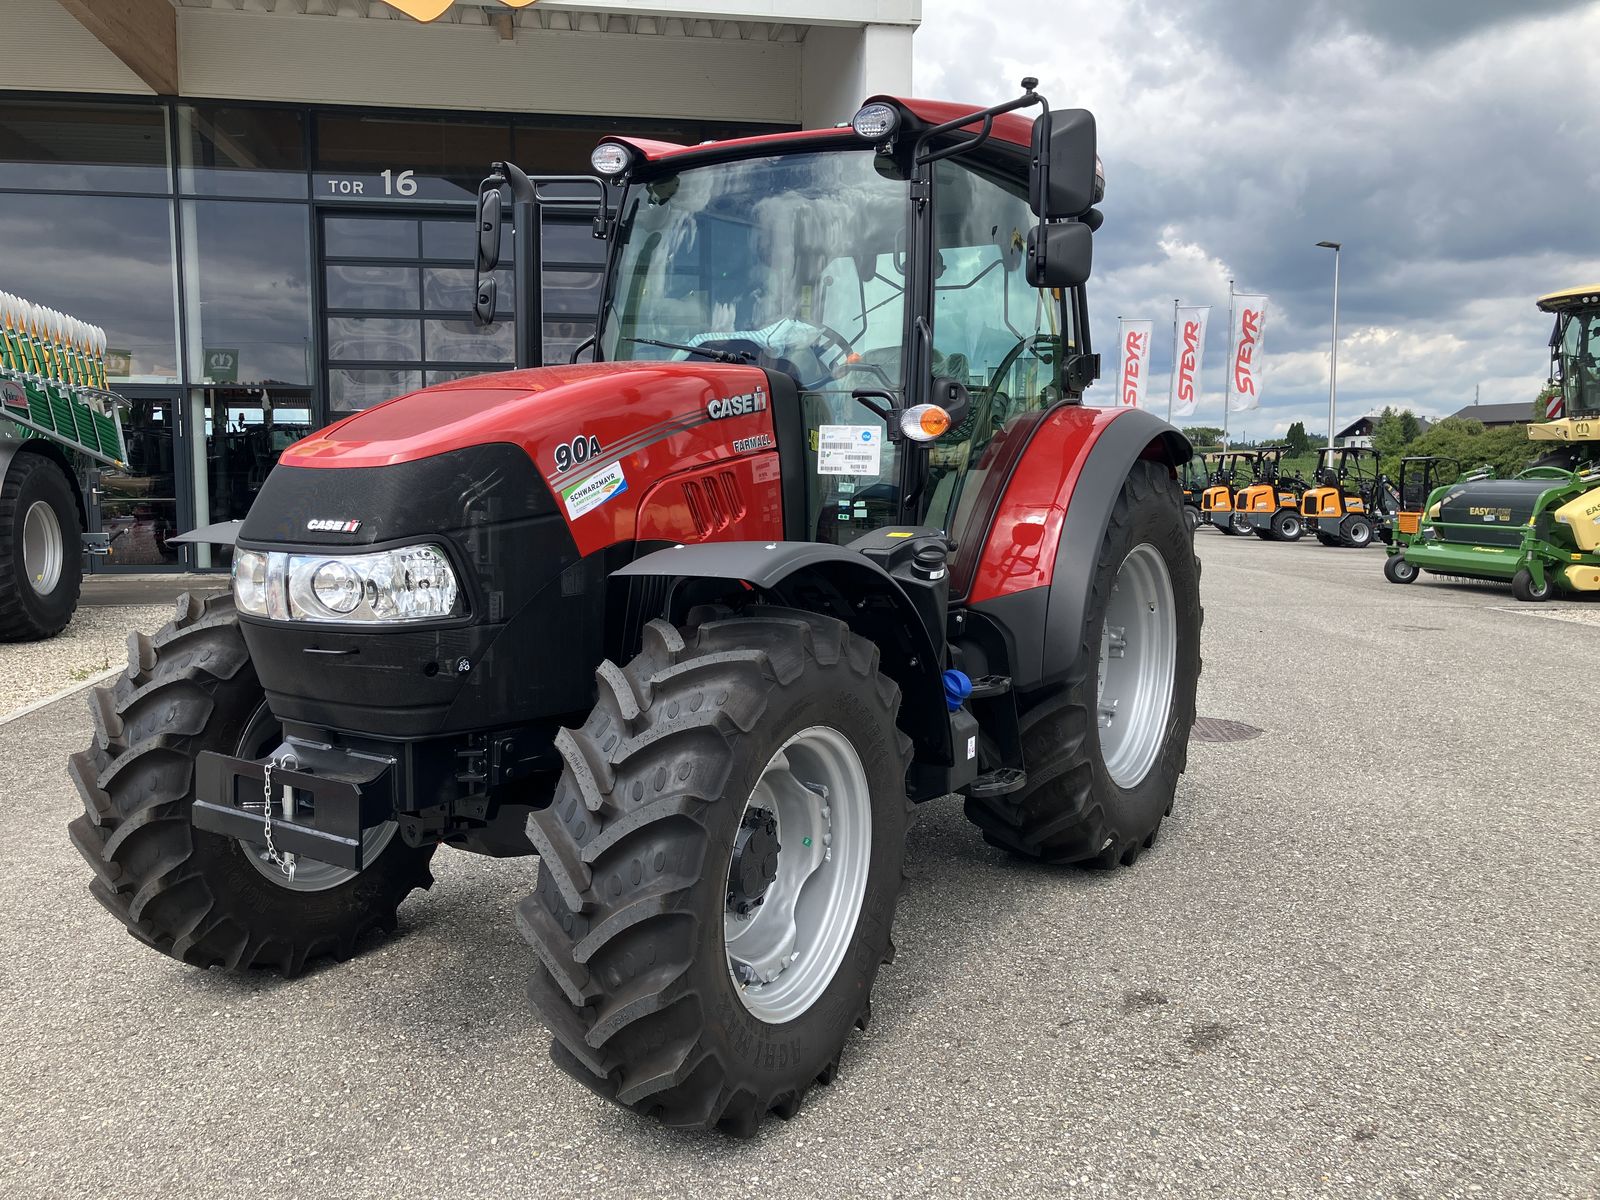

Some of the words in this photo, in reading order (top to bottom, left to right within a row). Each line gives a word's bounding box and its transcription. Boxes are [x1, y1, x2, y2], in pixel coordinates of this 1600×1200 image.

[328, 180, 364, 194] TOR
[380, 169, 418, 196] 16
[1123, 331, 1143, 407] STEYR
[1178, 321, 1199, 403] STEYR
[1235, 308, 1259, 396] STEYR
[554, 434, 603, 474] 90A
[732, 434, 772, 453] FARMALL
[570, 472, 616, 503] SCHWARZMAYR
